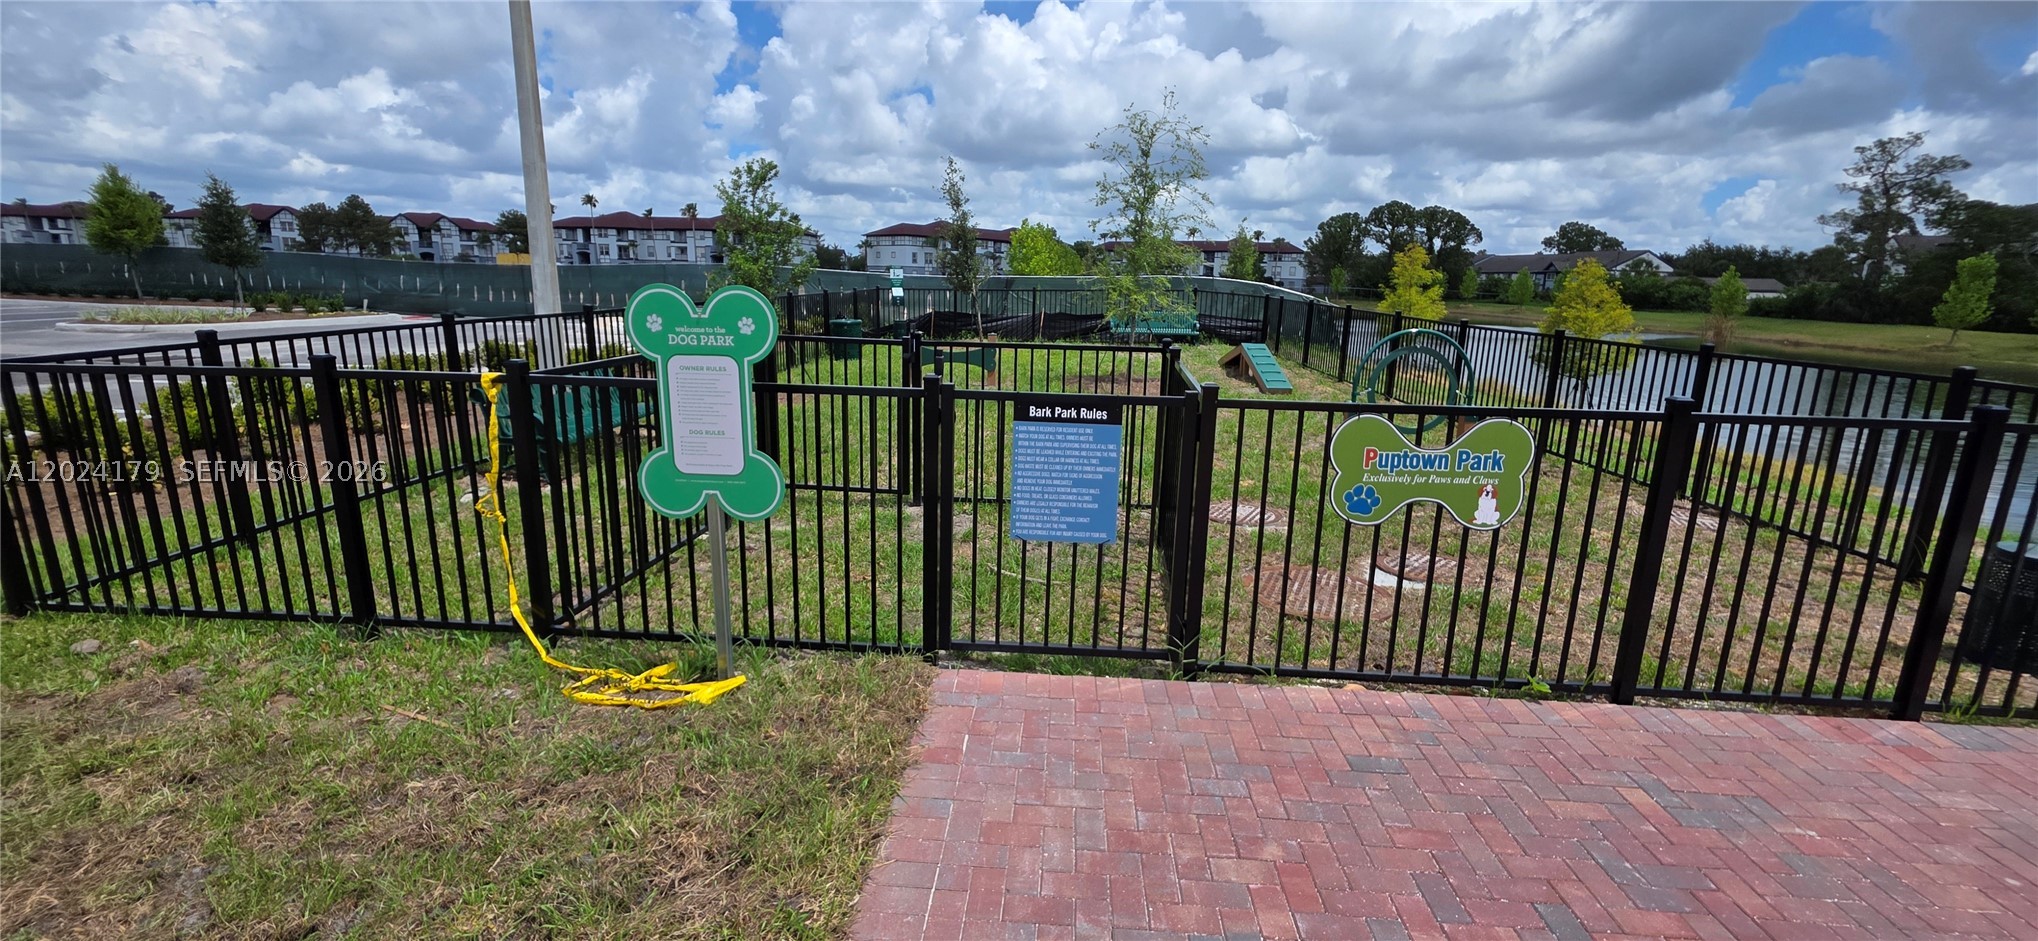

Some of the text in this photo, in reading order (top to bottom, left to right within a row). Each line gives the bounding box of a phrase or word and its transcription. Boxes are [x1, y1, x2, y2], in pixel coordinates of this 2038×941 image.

[675, 325, 705, 333] welcome
[668, 334, 734, 346] DOG PARK
[1029, 405, 1108, 420] Bark Park Rules
[1363, 447, 1506, 474] Puptown Park
[1362, 472, 1499, 485] Exclusively for Paws and Claws
